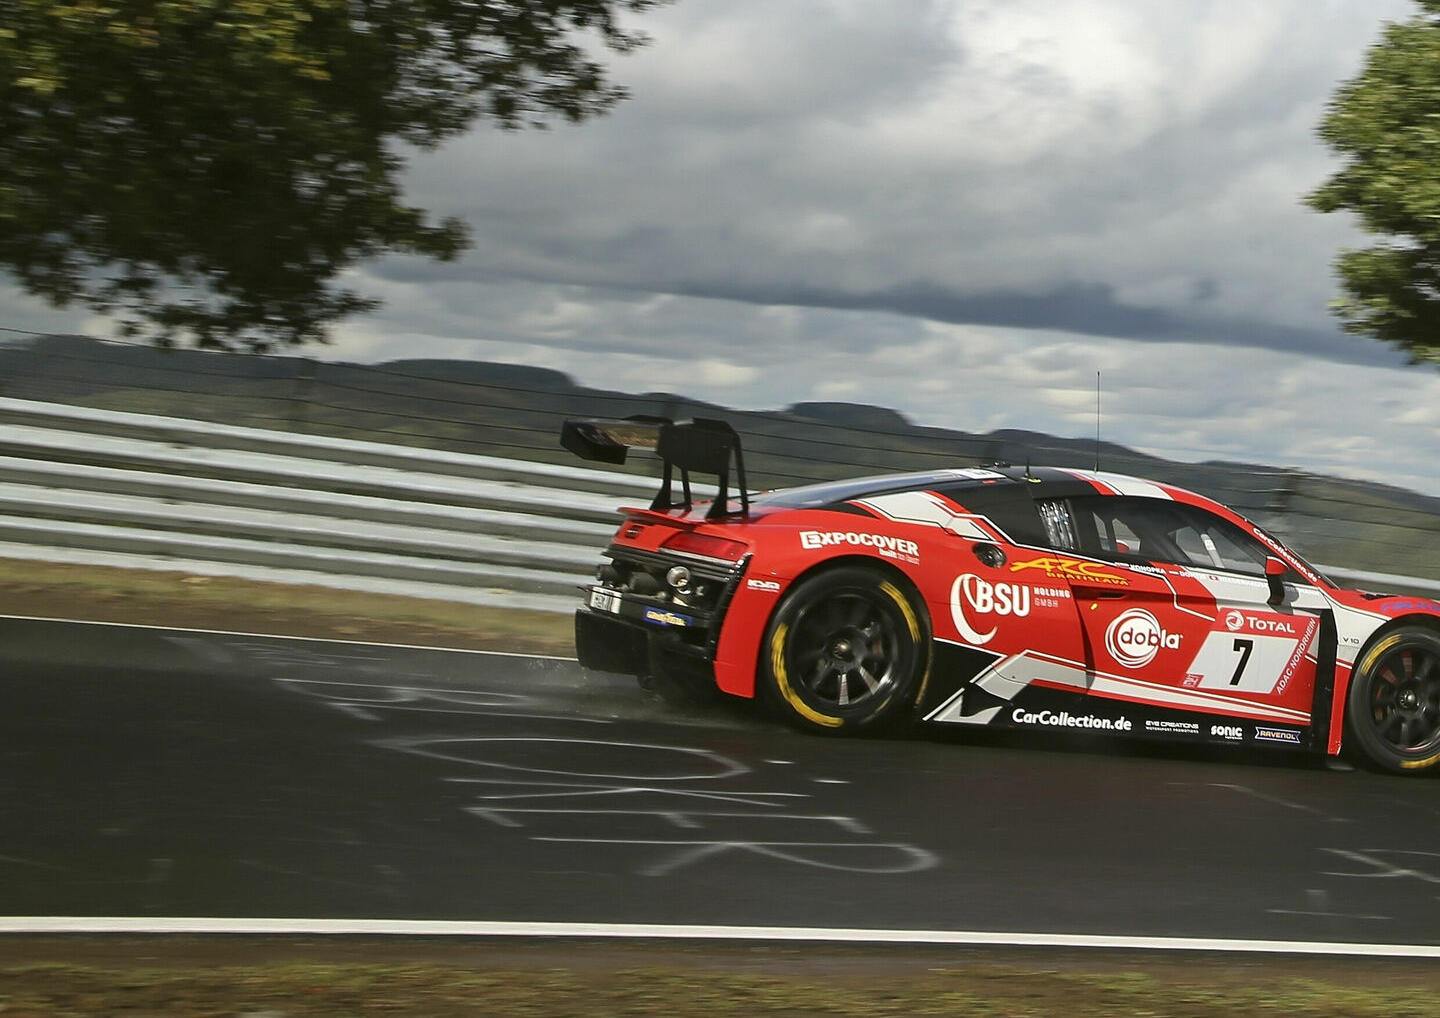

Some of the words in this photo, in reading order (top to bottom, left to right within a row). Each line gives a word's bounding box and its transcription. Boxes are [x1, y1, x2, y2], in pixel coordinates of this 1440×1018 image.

[799, 530, 920, 556] EXPOCOVER
[1253, 527, 1318, 582] CarCollection.de
[975, 580, 1031, 617] BSU
[1033, 587, 1071, 598] HOLDING
[1246, 616, 1296, 633] TOTAL
[1120, 627, 1181, 650] dobla
[1229, 638, 1254, 686] 7
[1275, 670, 1293, 694] ADAC
[1291, 617, 1316, 669] NORDRHEIN
[1012, 708, 1132, 731] CarCollection.de
[1260, 730, 1296, 740] RAVENOL
